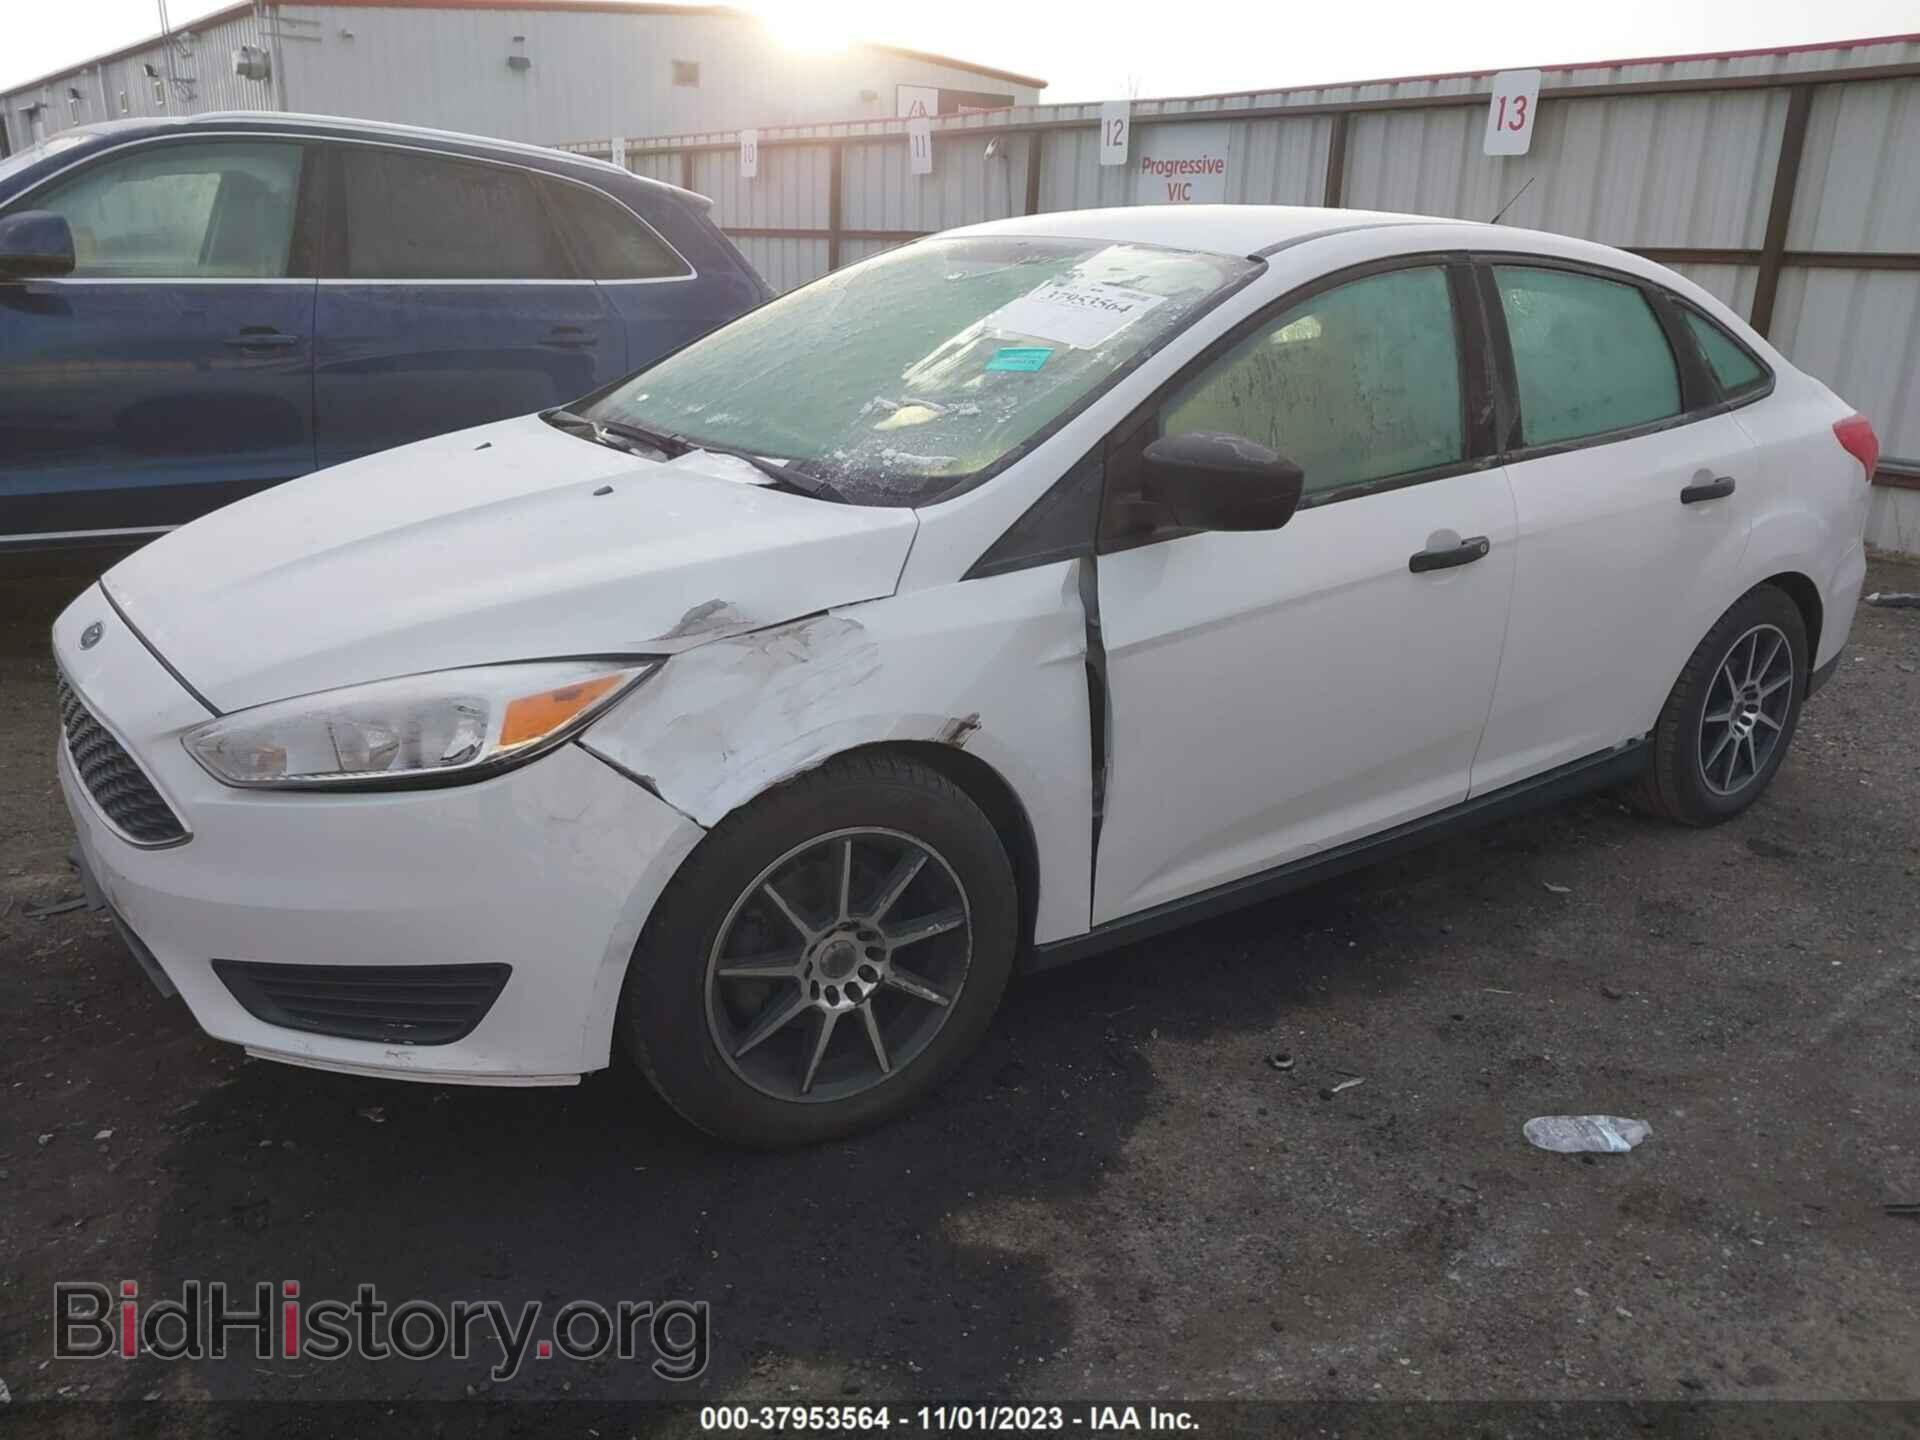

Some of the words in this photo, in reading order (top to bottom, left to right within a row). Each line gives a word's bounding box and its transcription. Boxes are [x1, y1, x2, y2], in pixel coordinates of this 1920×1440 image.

[1497, 95, 1527, 131] 13
[1106, 119, 1124, 147] 12
[743, 143, 754, 163] 10
[913, 134, 926, 158] 11
[1142, 154, 1224, 178] Progressive
[1167, 182, 1192, 201] VIC
